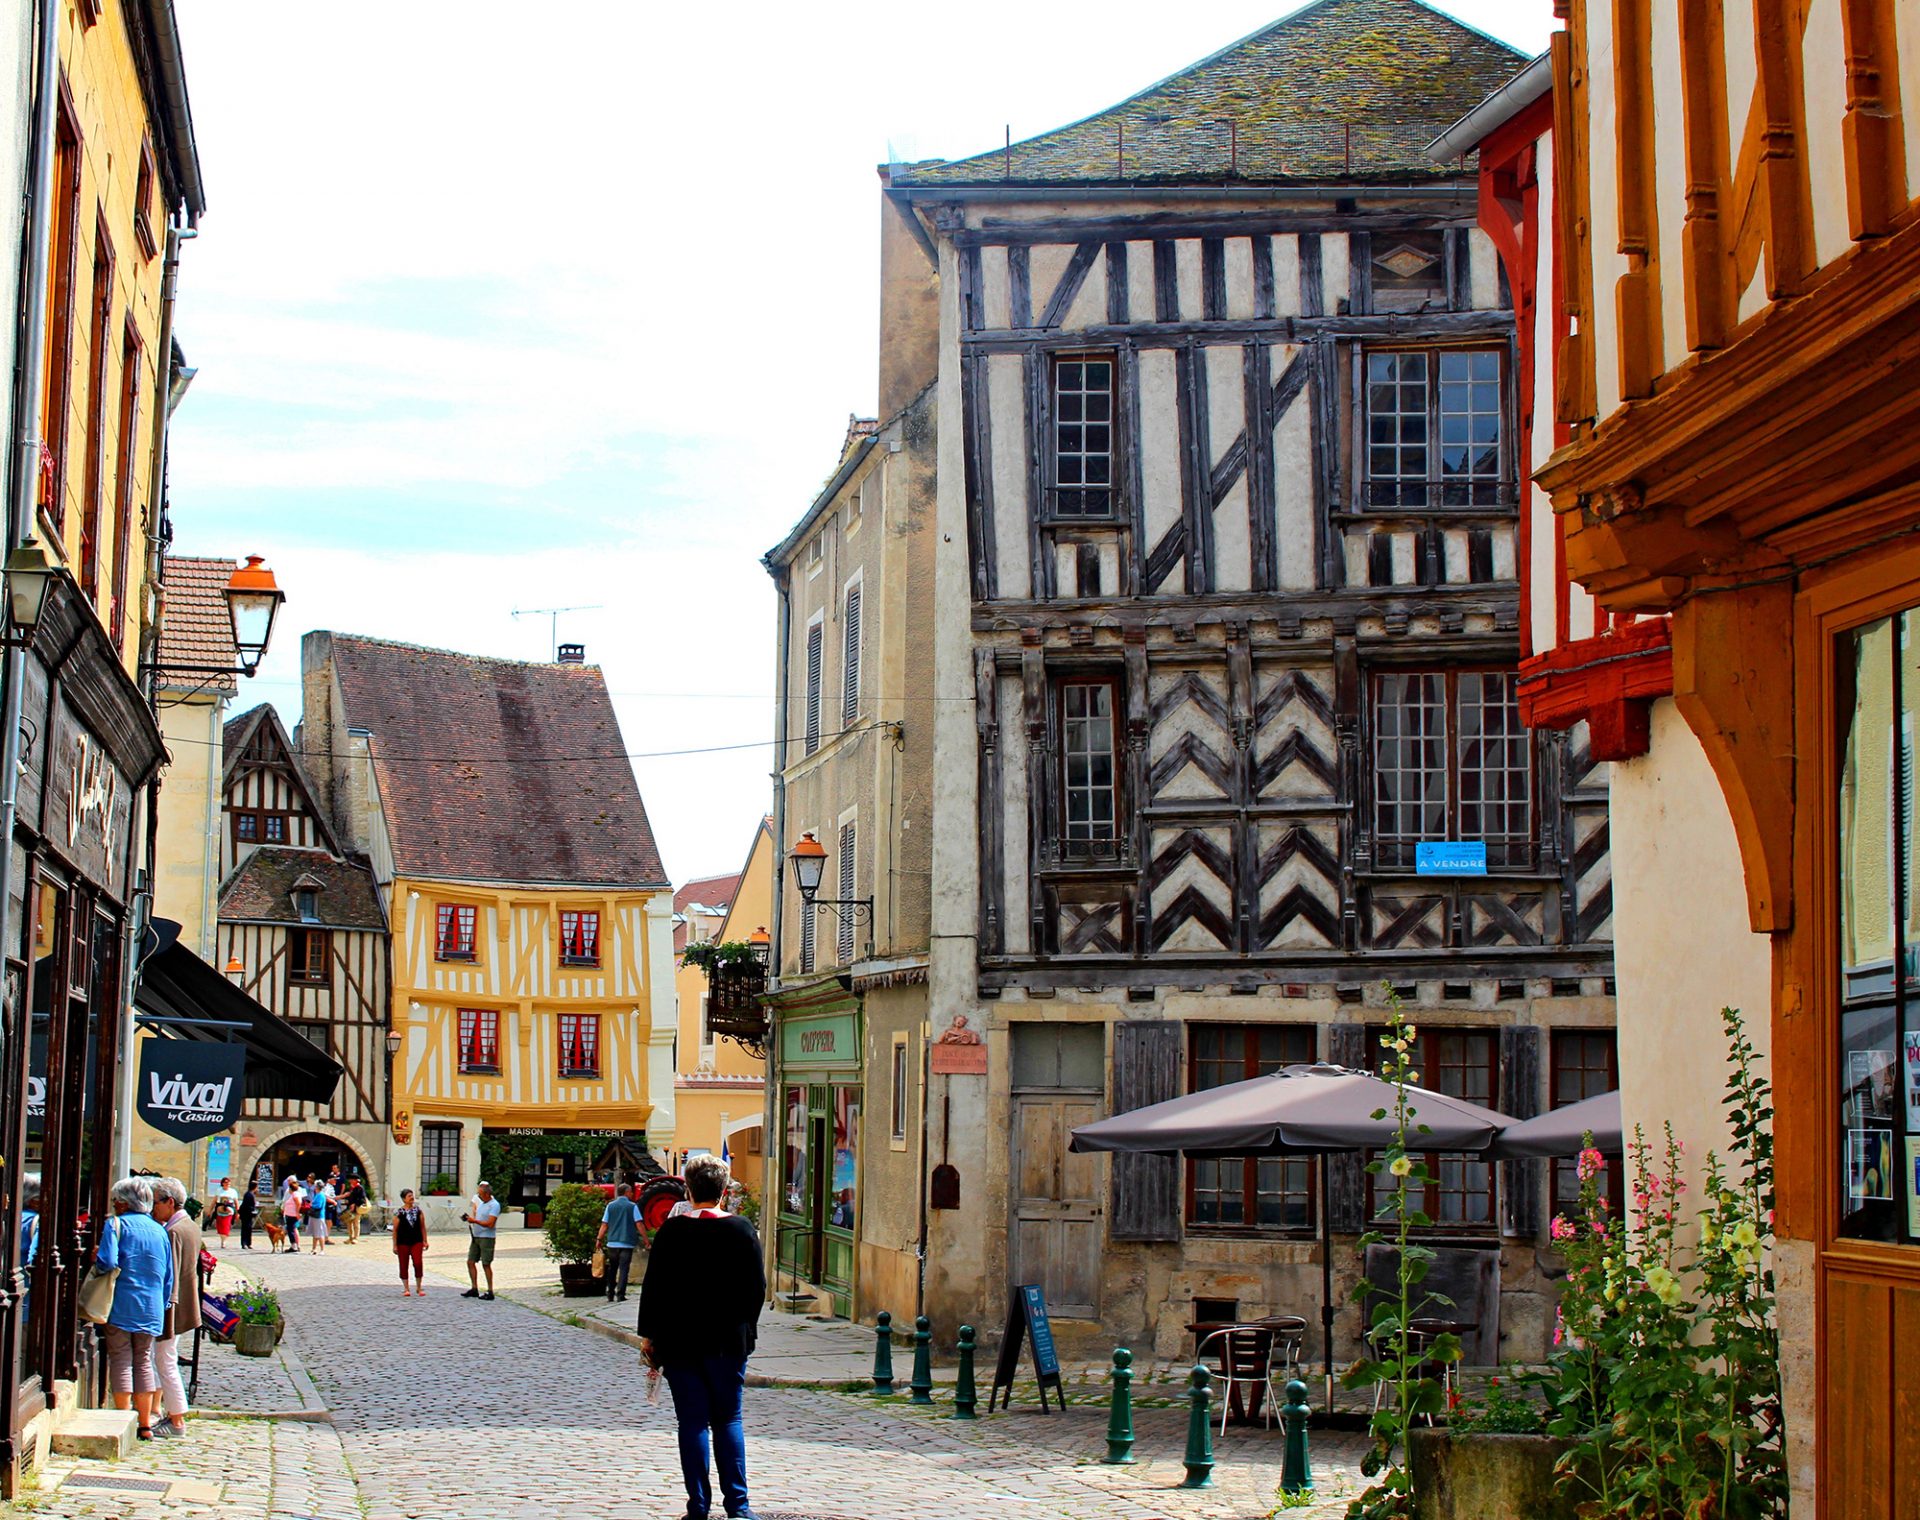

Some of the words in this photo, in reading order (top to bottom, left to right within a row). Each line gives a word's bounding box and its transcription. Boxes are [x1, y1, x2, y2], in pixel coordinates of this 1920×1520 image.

[1420, 860, 1428, 868] A
[1433, 860, 1485, 868] VENDRE
[168, 1112, 177, 1120] by
[177, 1110, 224, 1123] Casino
[509, 1127, 544, 1136] MAISON
